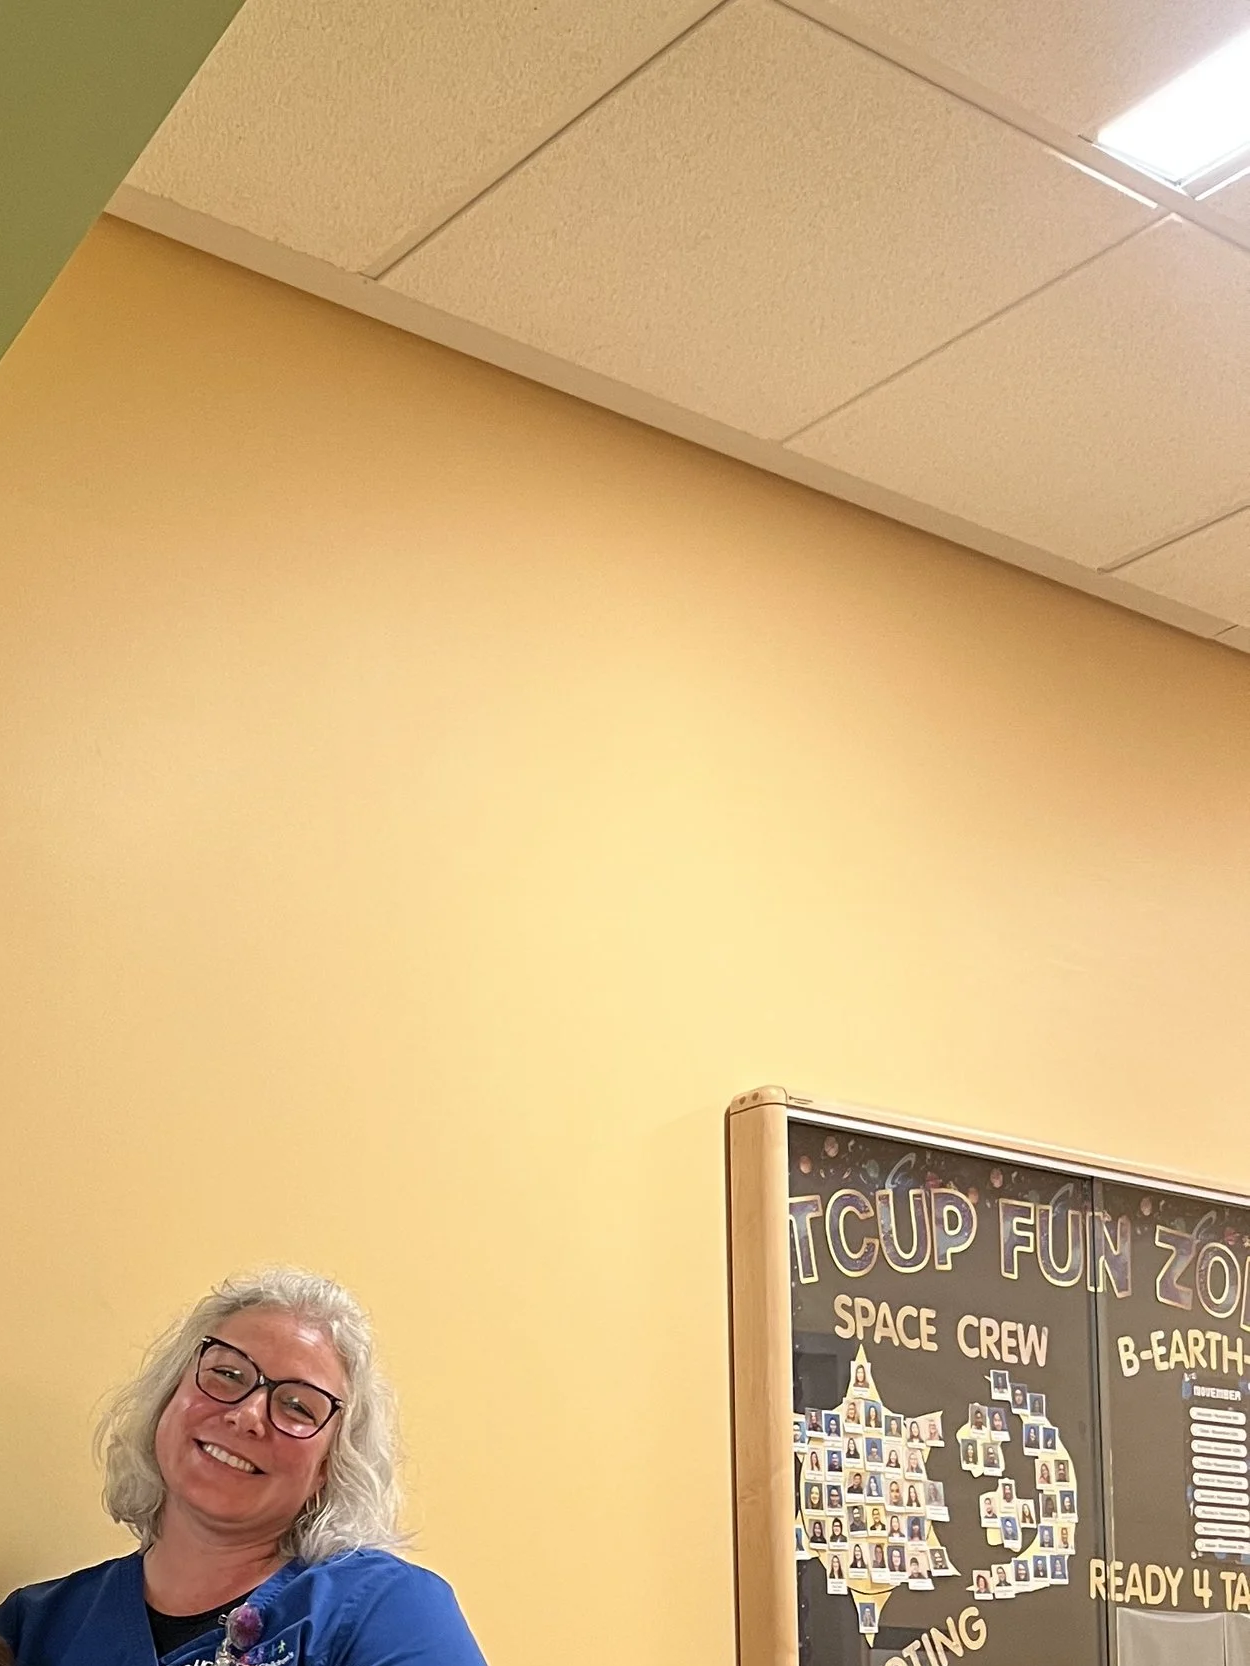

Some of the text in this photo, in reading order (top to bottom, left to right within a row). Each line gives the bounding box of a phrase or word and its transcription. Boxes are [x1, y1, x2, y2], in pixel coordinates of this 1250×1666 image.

[999, 1198, 1132, 1299] FUN
[834, 1294, 1048, 1367] SPACE CREW
[1193, 1385, 1241, 1401] NOVEMBER
[1090, 1558, 1184, 1607] READY
[1193, 1568, 1213, 1608] 4
